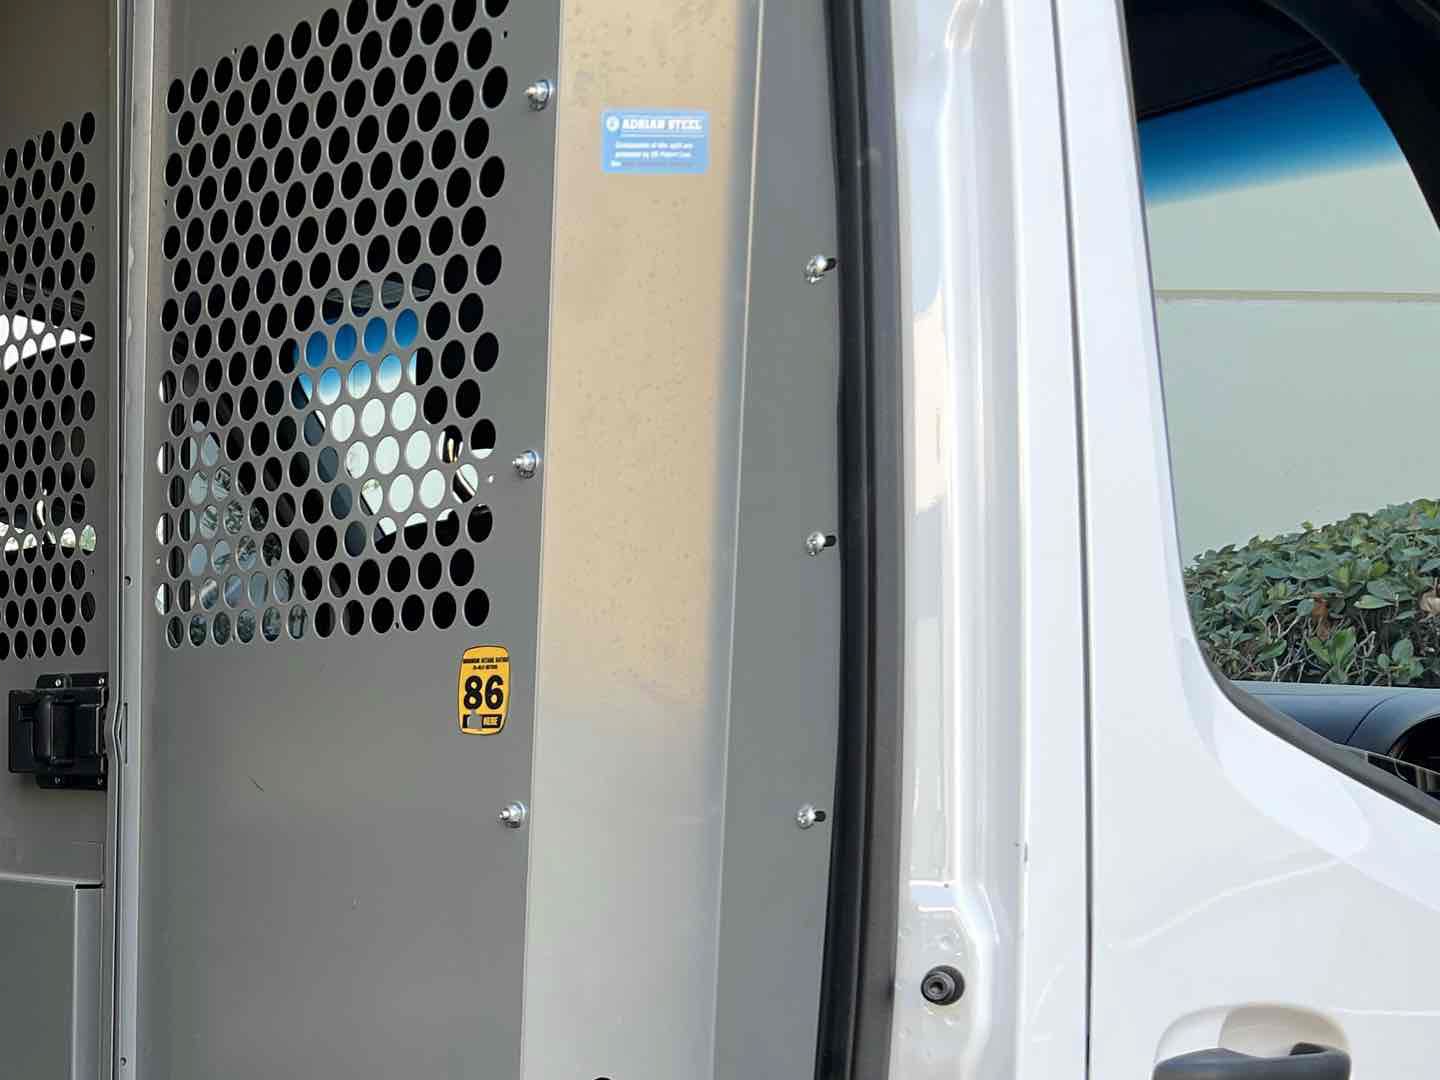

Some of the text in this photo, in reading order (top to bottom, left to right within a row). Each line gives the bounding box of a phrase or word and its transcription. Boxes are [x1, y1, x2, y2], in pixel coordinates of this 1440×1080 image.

[622, 119, 703, 130] ADRIAN STEEL
[463, 675, 504, 710] 86
